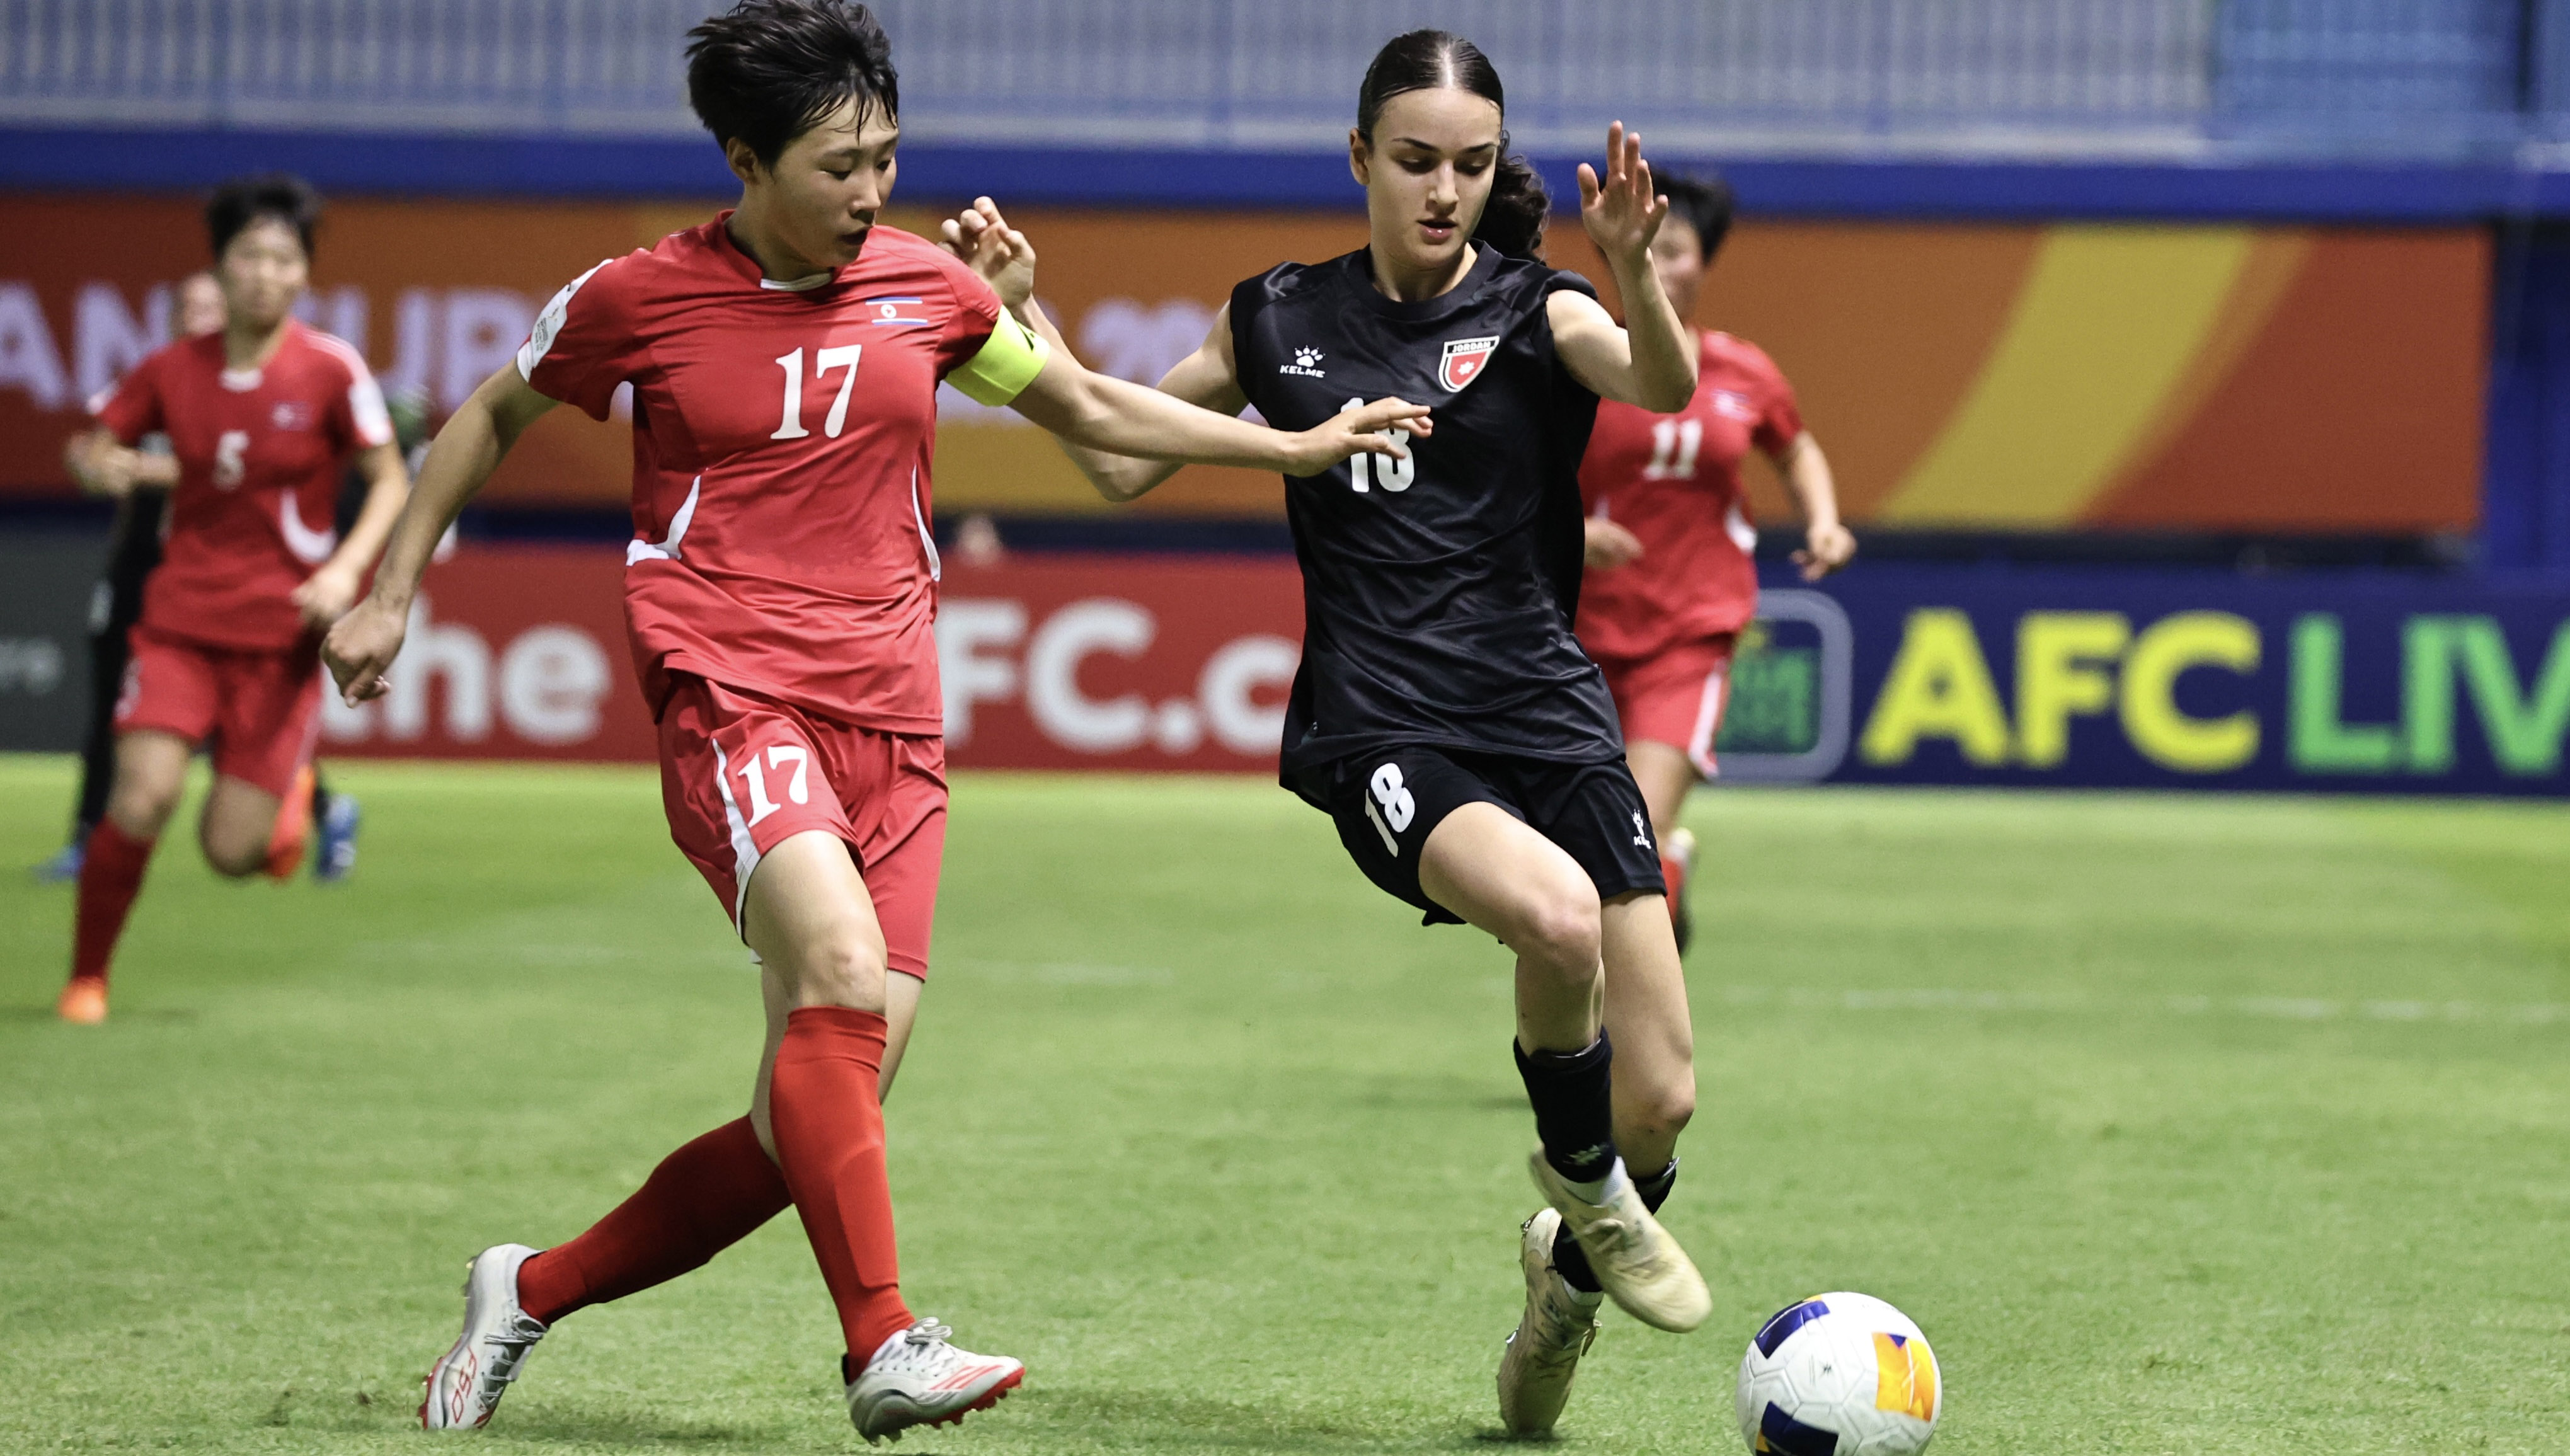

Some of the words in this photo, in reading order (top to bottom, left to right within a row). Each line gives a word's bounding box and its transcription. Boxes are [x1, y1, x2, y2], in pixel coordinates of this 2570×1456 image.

[1280, 365, 1326, 378] KELME
[1452, 341, 1491, 353] JORDAN
[770, 344, 862, 440] 17
[214, 430, 249, 490] 5
[1341, 397, 1415, 493] 18
[1643, 417, 1704, 481] 11
[1860, 607, 2261, 774] AFC
[2287, 612, 2570, 776] LIV
[737, 745, 809, 828] 17
[1365, 762, 1415, 858] 18
[452, 1345, 477, 1424] F50
